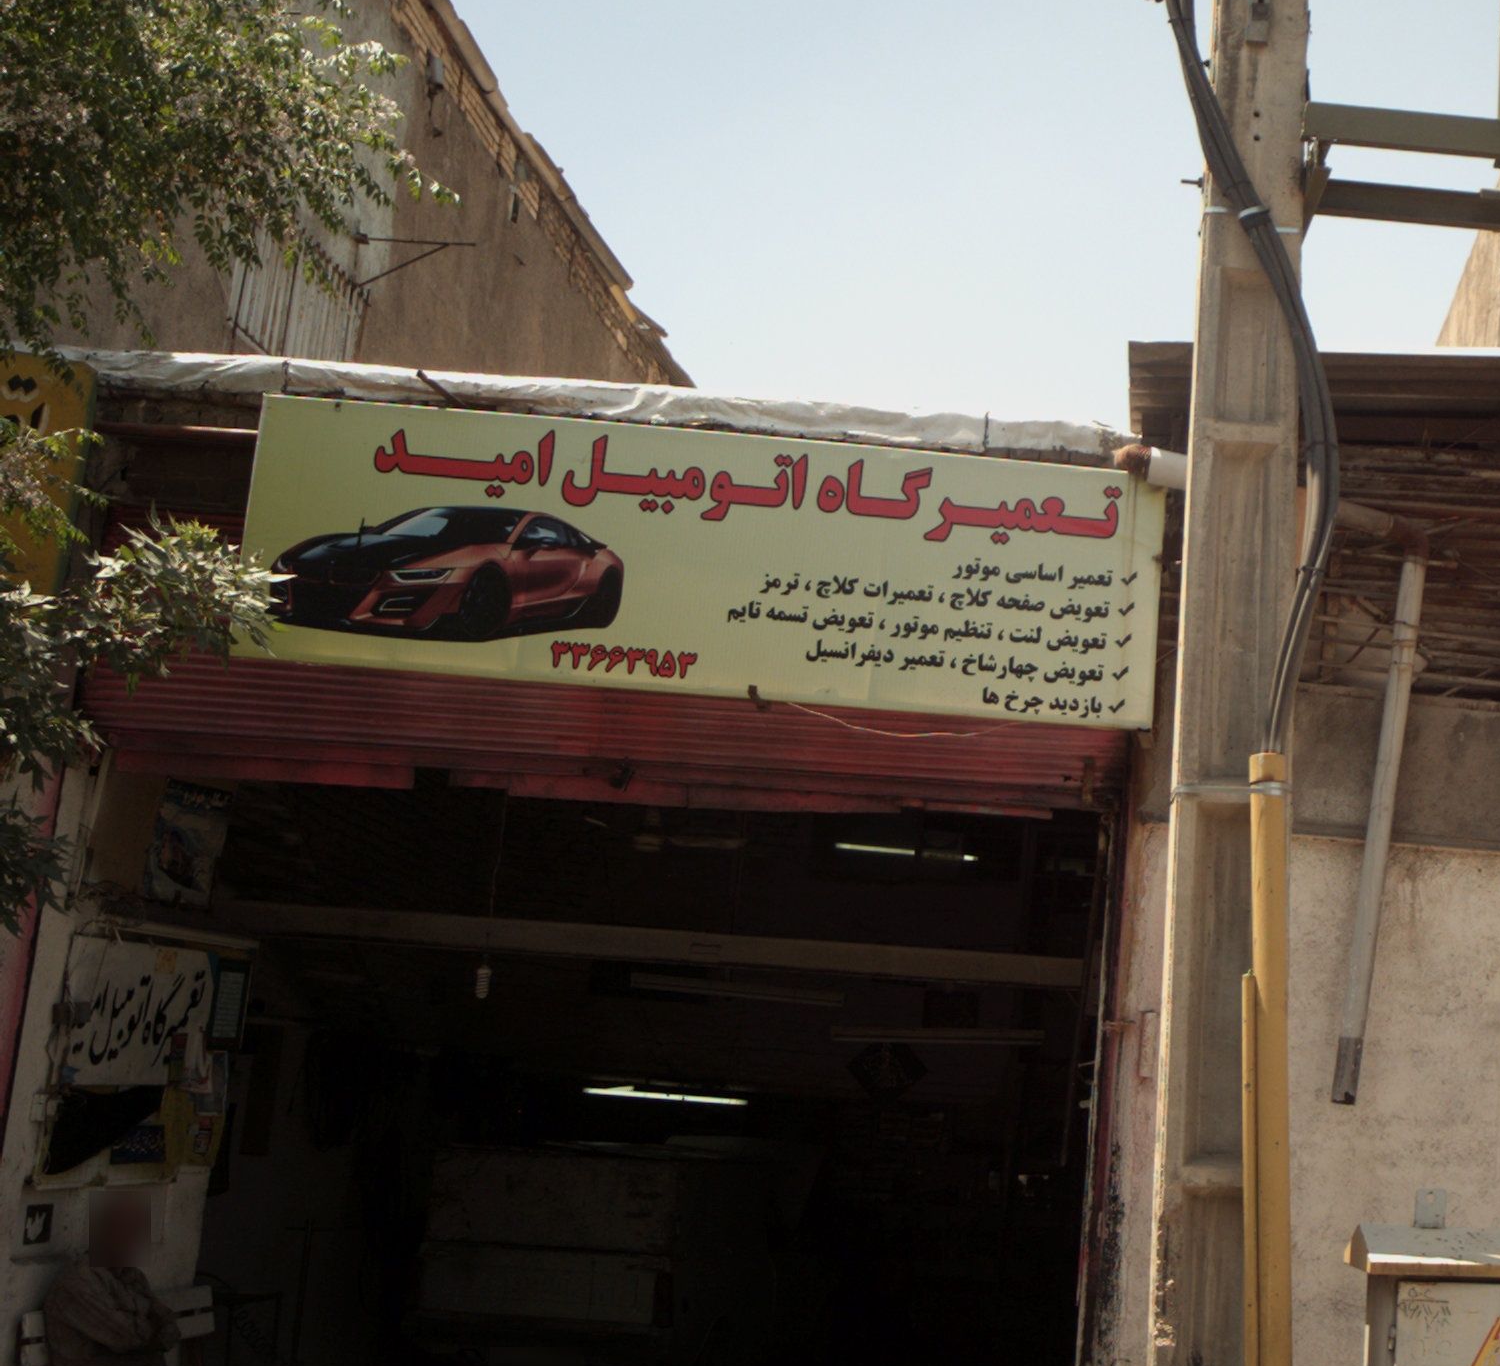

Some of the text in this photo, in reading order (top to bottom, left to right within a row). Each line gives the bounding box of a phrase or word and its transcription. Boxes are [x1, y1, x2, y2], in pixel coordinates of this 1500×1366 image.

[373, 428, 1123, 545] تعمیرگاه اتومبیل امید
[759, 573, 800, 595] ترمز
[952, 557, 1113, 590] تعمیر اساسی موتور
[816, 575, 859, 599] کلاچ
[863, 580, 935, 605] تعمیرات
[950, 587, 993, 610] کلاچ
[727, 600, 762, 623] تایم
[766, 605, 809, 624] تسمه
[996, 594, 1046, 612] صفحه
[1049, 598, 1111, 623] تعویض
[812, 608, 875, 633] تعویض
[890, 615, 939, 640] موتور
[944, 620, 993, 642] تنظیم
[1009, 626, 1043, 644] لنت
[1046, 629, 1108, 654] تعویض
[551, 640, 699, 680] ۳۳۶۶۳۹۵۳
[805, 639, 895, 668] دیفرانسیل
[898, 650, 946, 671] تعمیر
[1043, 661, 1105, 687] تعویض
[1003, 690, 1044, 716] چرخ
[1049, 695, 1103, 720] بازدید
